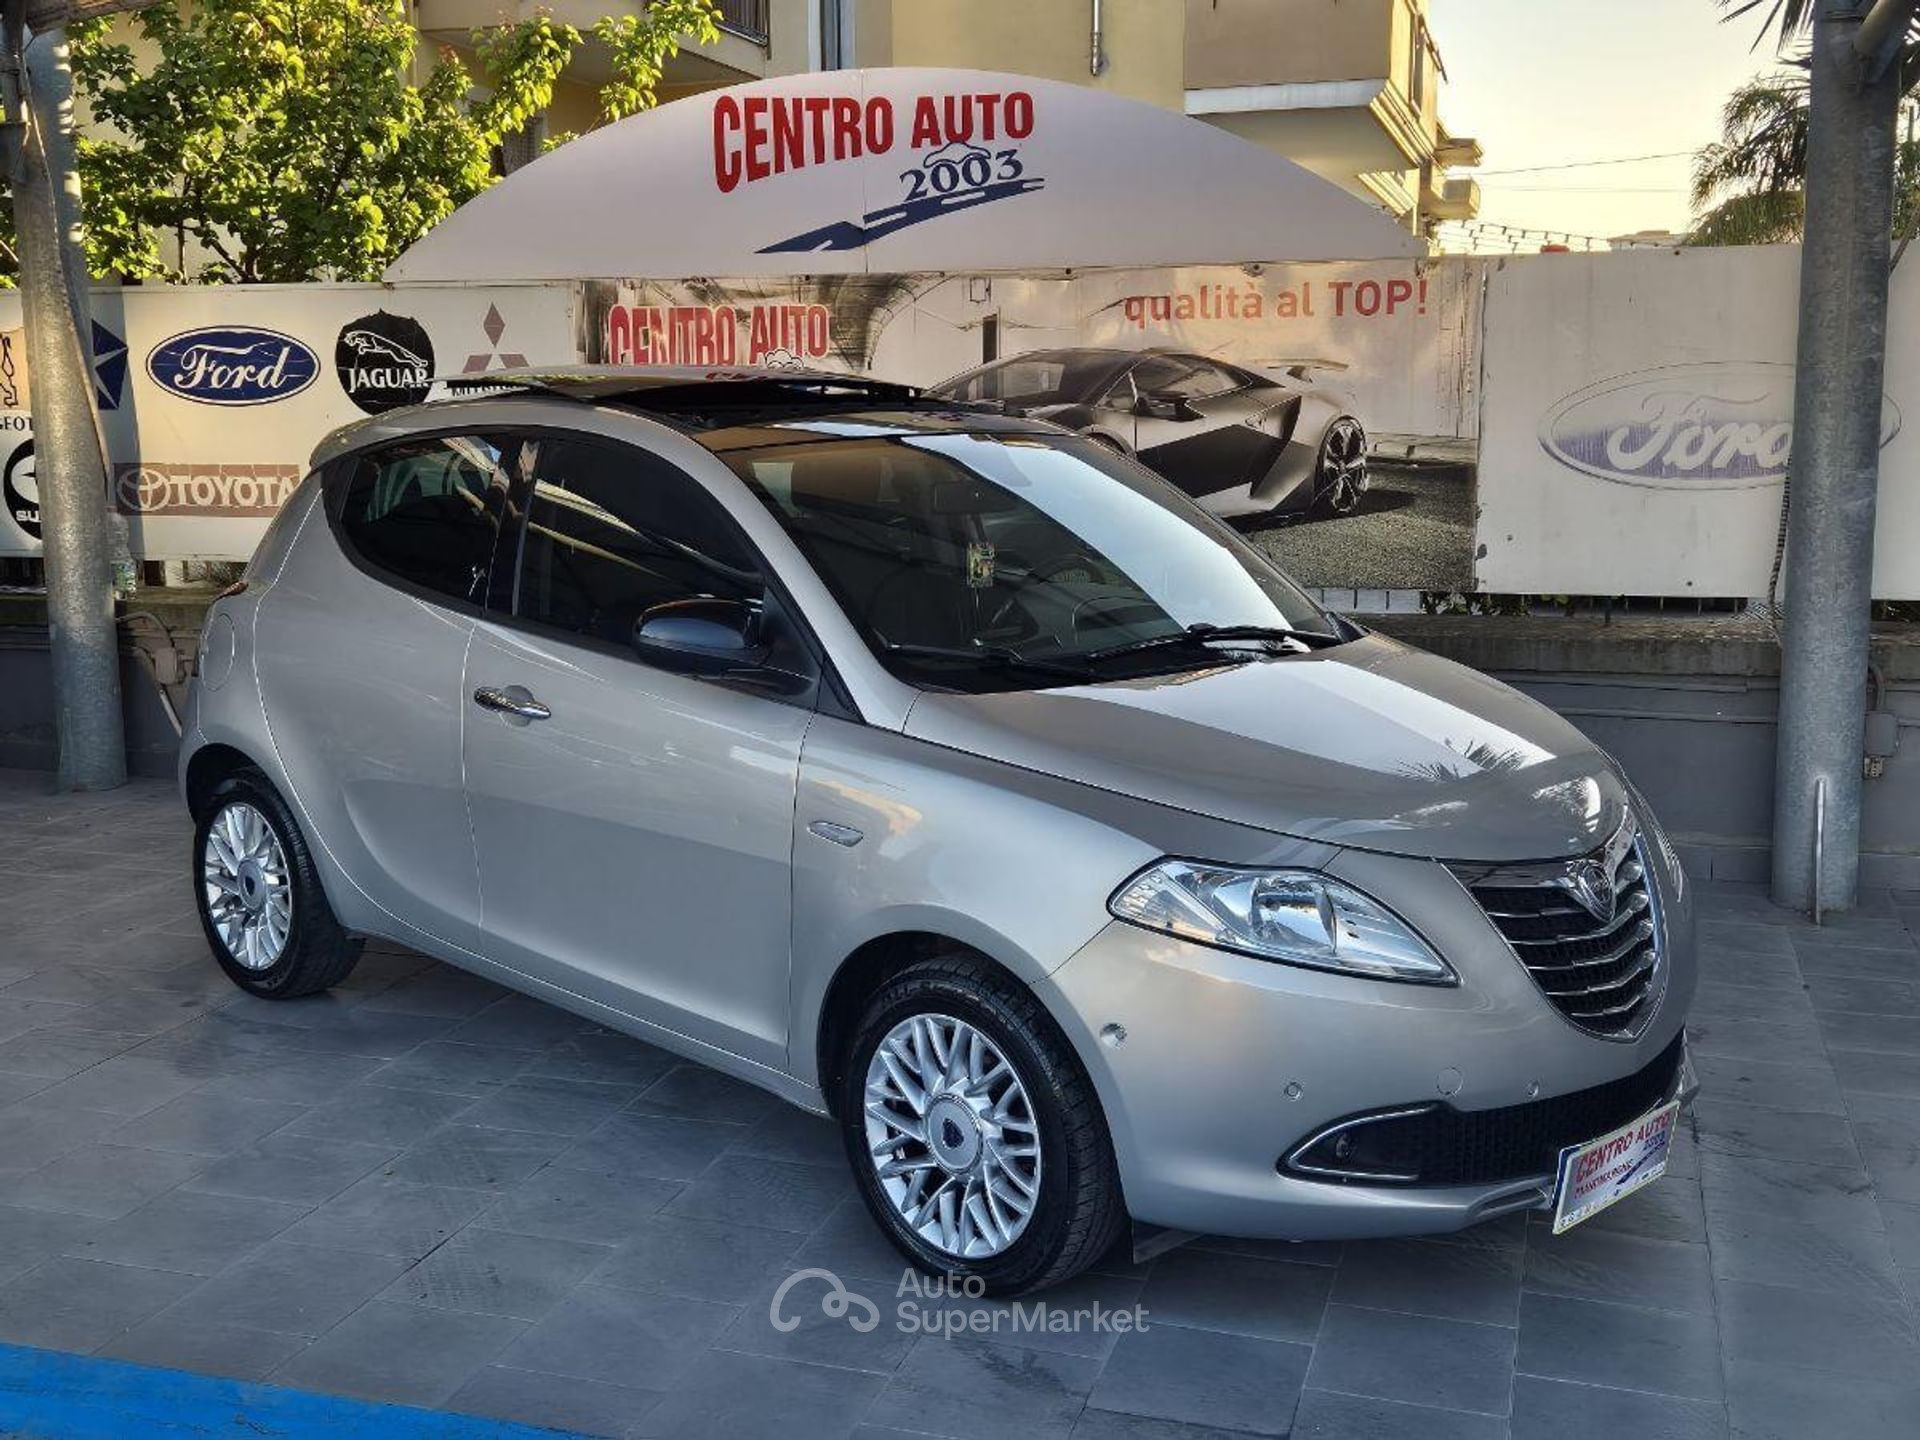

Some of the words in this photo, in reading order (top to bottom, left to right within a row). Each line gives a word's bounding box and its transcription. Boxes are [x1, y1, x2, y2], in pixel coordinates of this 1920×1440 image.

[713, 95, 894, 193] CENTRO
[911, 91, 1034, 149] AUTO
[899, 148, 1024, 201] 2003
[1125, 281, 1263, 329] qualità
[1277, 282, 1314, 318] al
[1328, 279, 1428, 317] TOP!
[609, 304, 736, 366] CENTRO
[749, 303, 828, 366] AUTO
[174, 338, 291, 391] Ford
[349, 367, 429, 393] JAGUAR
[1576, 1131, 1633, 1183] CENTRO
[1635, 1112, 1671, 1144] AUTO
